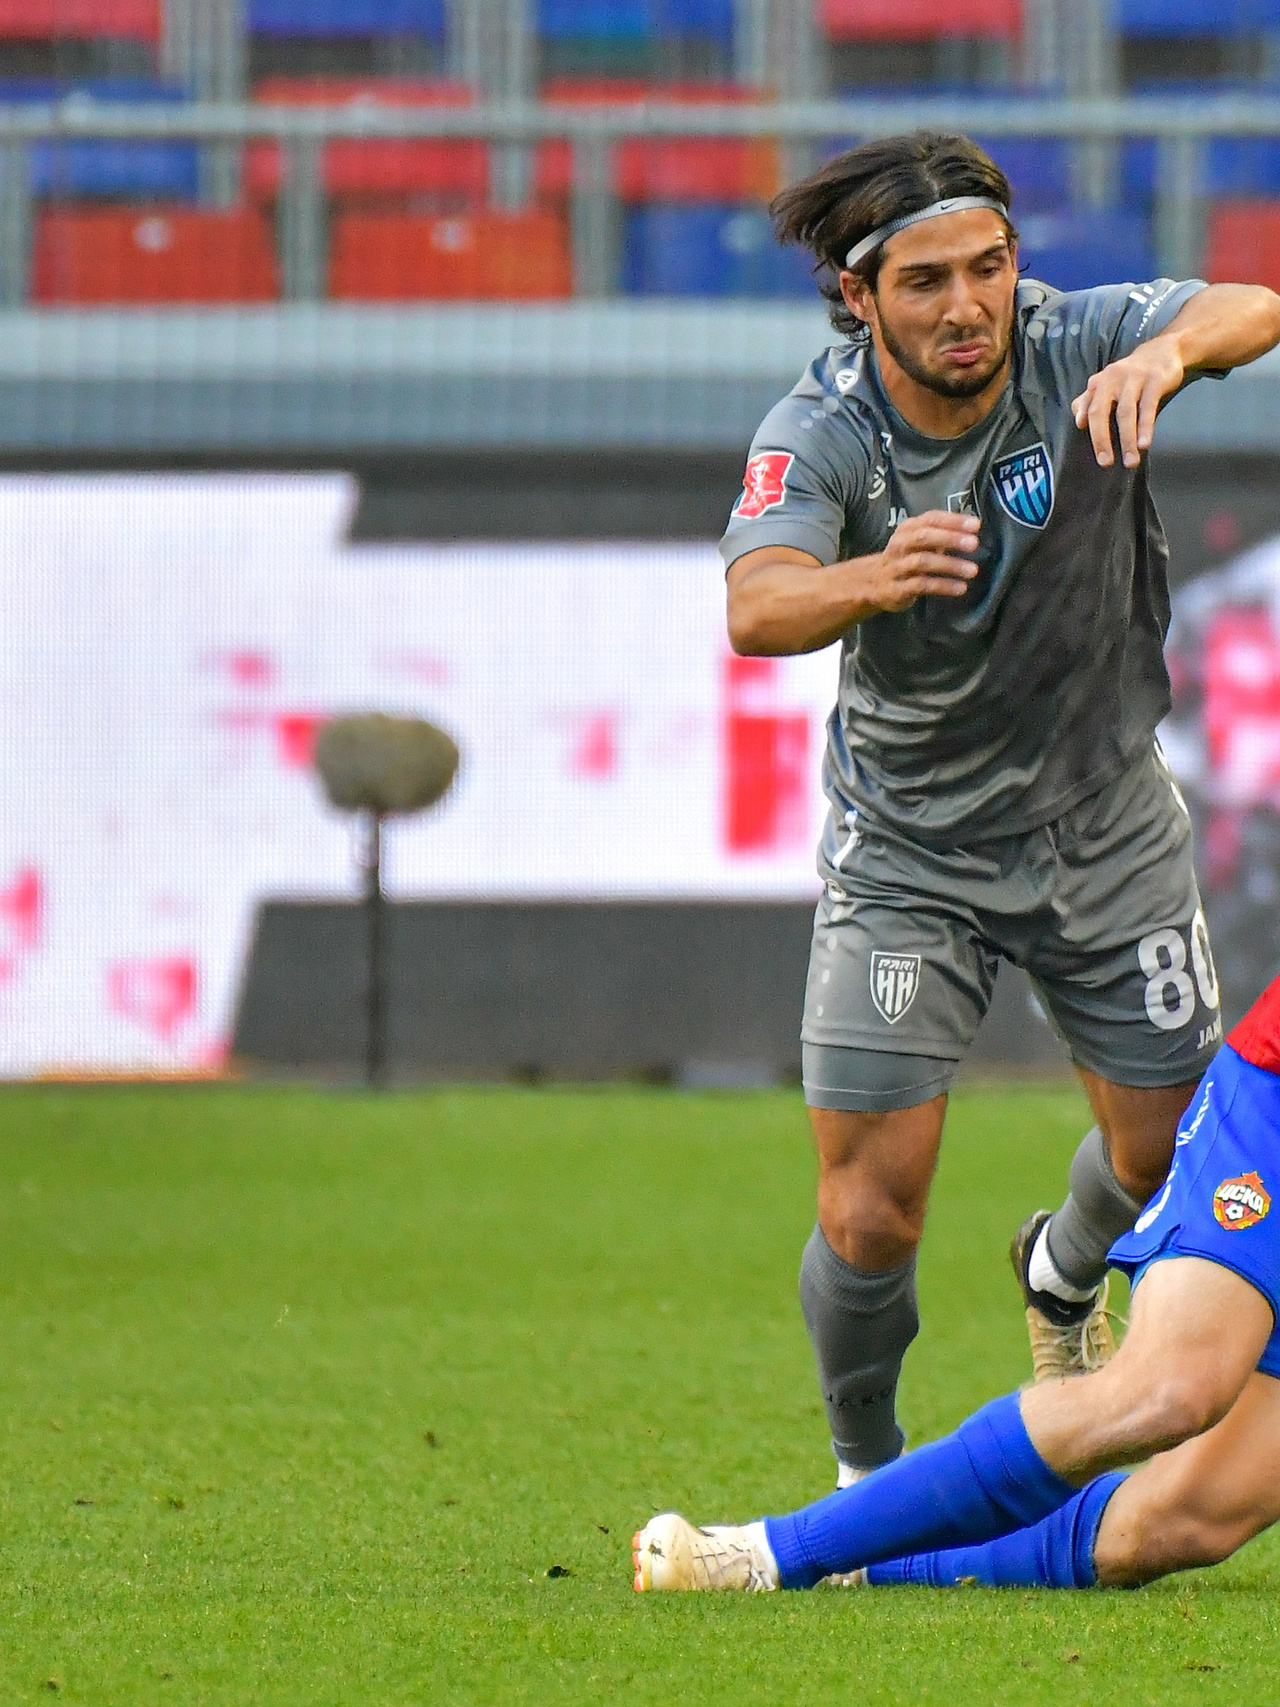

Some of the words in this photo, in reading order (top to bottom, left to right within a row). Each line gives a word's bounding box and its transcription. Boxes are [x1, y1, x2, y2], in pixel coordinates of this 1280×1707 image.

[1000, 454, 1040, 479] PARI
[878, 958, 915, 971] PARI
[1138, 908, 1219, 1030] 80
[1216, 1184, 1264, 1216] ЦСКА
